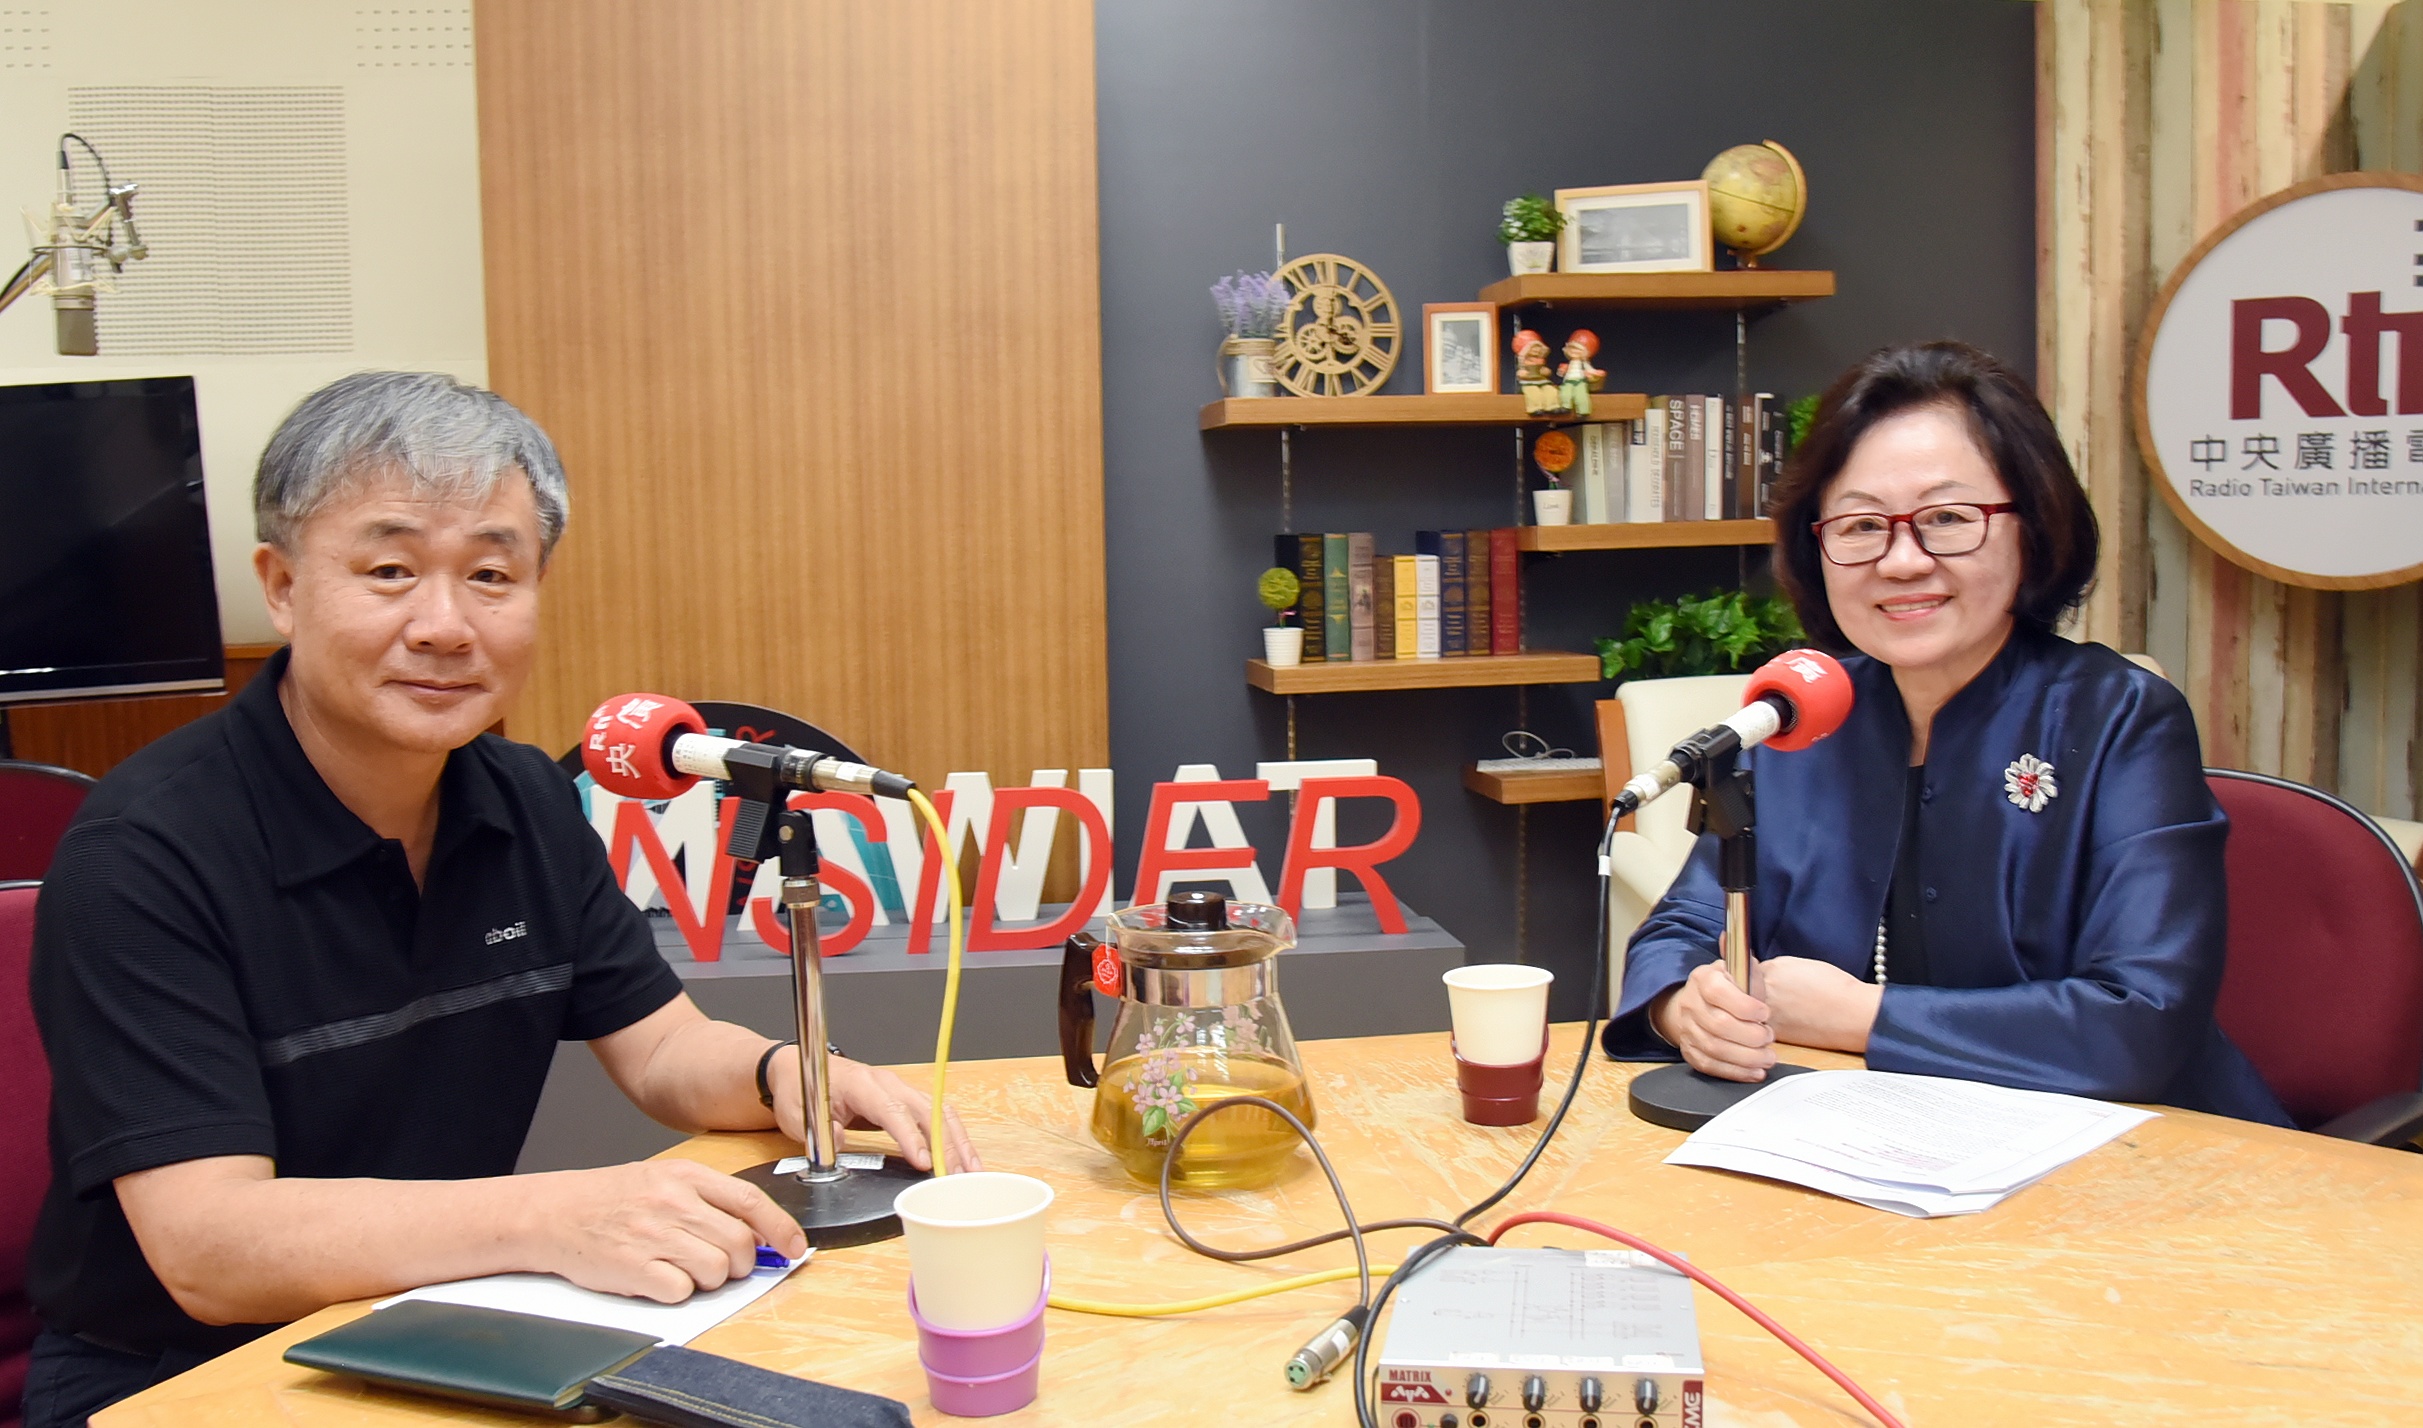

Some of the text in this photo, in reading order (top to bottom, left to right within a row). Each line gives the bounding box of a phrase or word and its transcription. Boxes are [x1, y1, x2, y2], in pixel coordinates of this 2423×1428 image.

[1669, 399, 1685, 450] SPACE
[2190, 476, 2423, 497] Radio Taiwan Intern
[606, 775, 1423, 962] NSIDER
[1389, 1368, 1432, 1382] MATRIX
